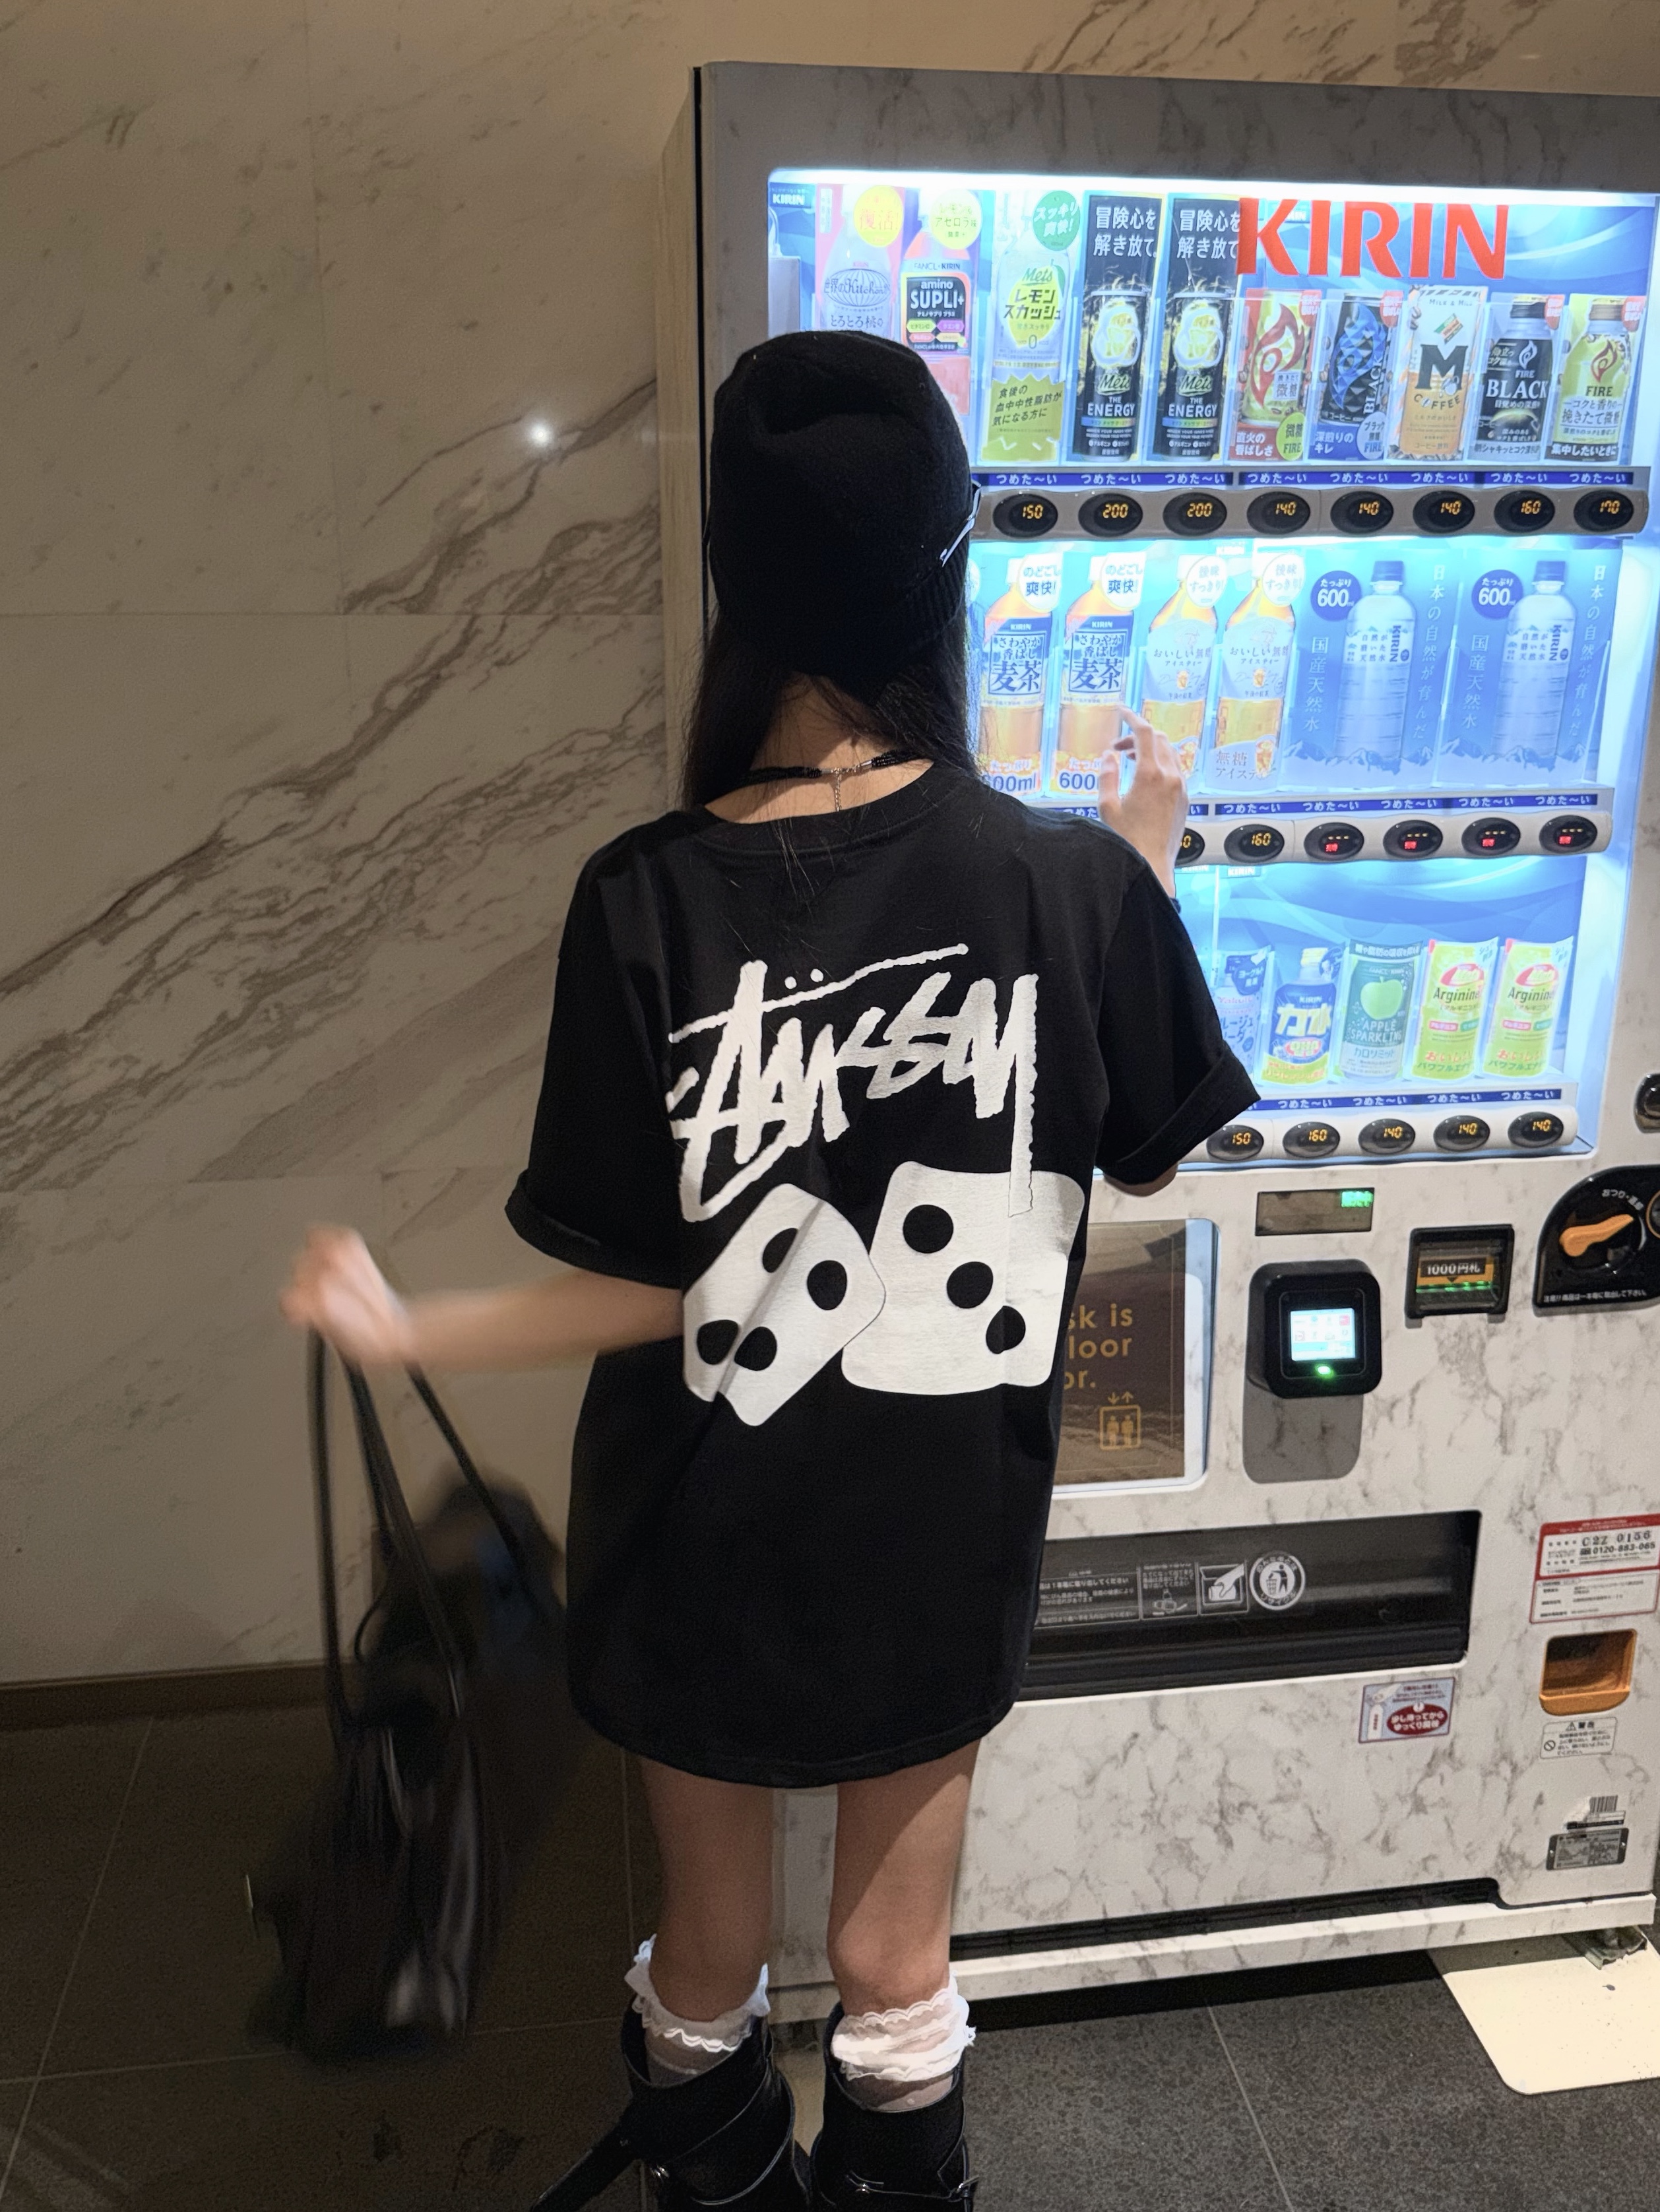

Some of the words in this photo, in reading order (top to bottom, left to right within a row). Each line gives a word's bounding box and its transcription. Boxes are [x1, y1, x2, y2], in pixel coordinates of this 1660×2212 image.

[773, 193, 805, 205] KIRIN
[1034, 201, 1079, 222] スッキリ
[1097, 206, 1156, 230] 冒険心を
[1093, 234, 1158, 258] 解き放て。
[1236, 198, 1510, 280] KIRIN
[1024, 269, 1053, 282] Mets
[920, 279, 954, 290] amino
[1015, 289, 1056, 303] レモン
[1004, 305, 1061, 320] スカッシュ
[1415, 344, 1469, 391] M
[1516, 369, 1535, 378] FIRE
[1486, 379, 1548, 399] BLACK
[1586, 387, 1613, 397] FIRE
[992, 408, 1048, 427] 気になる方に
[1088, 404, 1135, 417] ENERGY
[1168, 404, 1217, 418] ENERGY
[1236, 433, 1265, 443] 直火の
[1235, 446, 1273, 457] 香ばしさ
[1283, 443, 1301, 454] FIRE
[1314, 443, 1334, 454] キレ
[1364, 442, 1383, 453] FIRE
[1023, 503, 1044, 519] 150
[1102, 503, 1128, 519] 200
[1187, 503, 1213, 517] 200
[1275, 501, 1296, 517] 140
[1358, 501, 1380, 515] 140
[1440, 501, 1461, 515] 140
[1521, 500, 1541, 515] 160
[1320, 579, 1351, 588] たっぷり
[1481, 578, 1514, 587] たっぷり
[999, 637, 1041, 648] さわやか
[1079, 635, 1122, 647] さわやか
[1389, 624, 1401, 662] KIRIN
[1548, 624, 1562, 661] KIRIN
[1003, 649, 1036, 660] 香ばし
[1084, 647, 1117, 658] 香ばし
[1413, 564, 1445, 740] 日本の自然が育んだ
[1568, 565, 1606, 737] 日本の自然が育んだ
[992, 660, 1042, 692] 麦茶
[1071, 658, 1122, 690] 麦茶
[1304, 636, 1329, 732] 国産天然水
[1461, 633, 1489, 730] 国産天然水
[1216, 750, 1247, 766] 無糖
[1252, 833, 1271, 847] 160
[1228, 868, 1255, 876] KIRIN
[1362, 1021, 1397, 1031] APPLE
[1351, 1030, 1402, 1043] SPARKLING
[1355, 1046, 1395, 1059] カロリミット
[1384, 1126, 1403, 1139] 140
[1459, 1123, 1477, 1135] 140
[1532, 1120, 1551, 1132] 140
[1232, 1133, 1251, 1145] 150
[1308, 1129, 1327, 1142] 160
[1426, 1263, 1481, 1276] 1000円札
[1110, 1303, 1133, 1327] is
[1069, 1335, 1132, 1359] loor
[1064, 1370, 1095, 1389] or.
